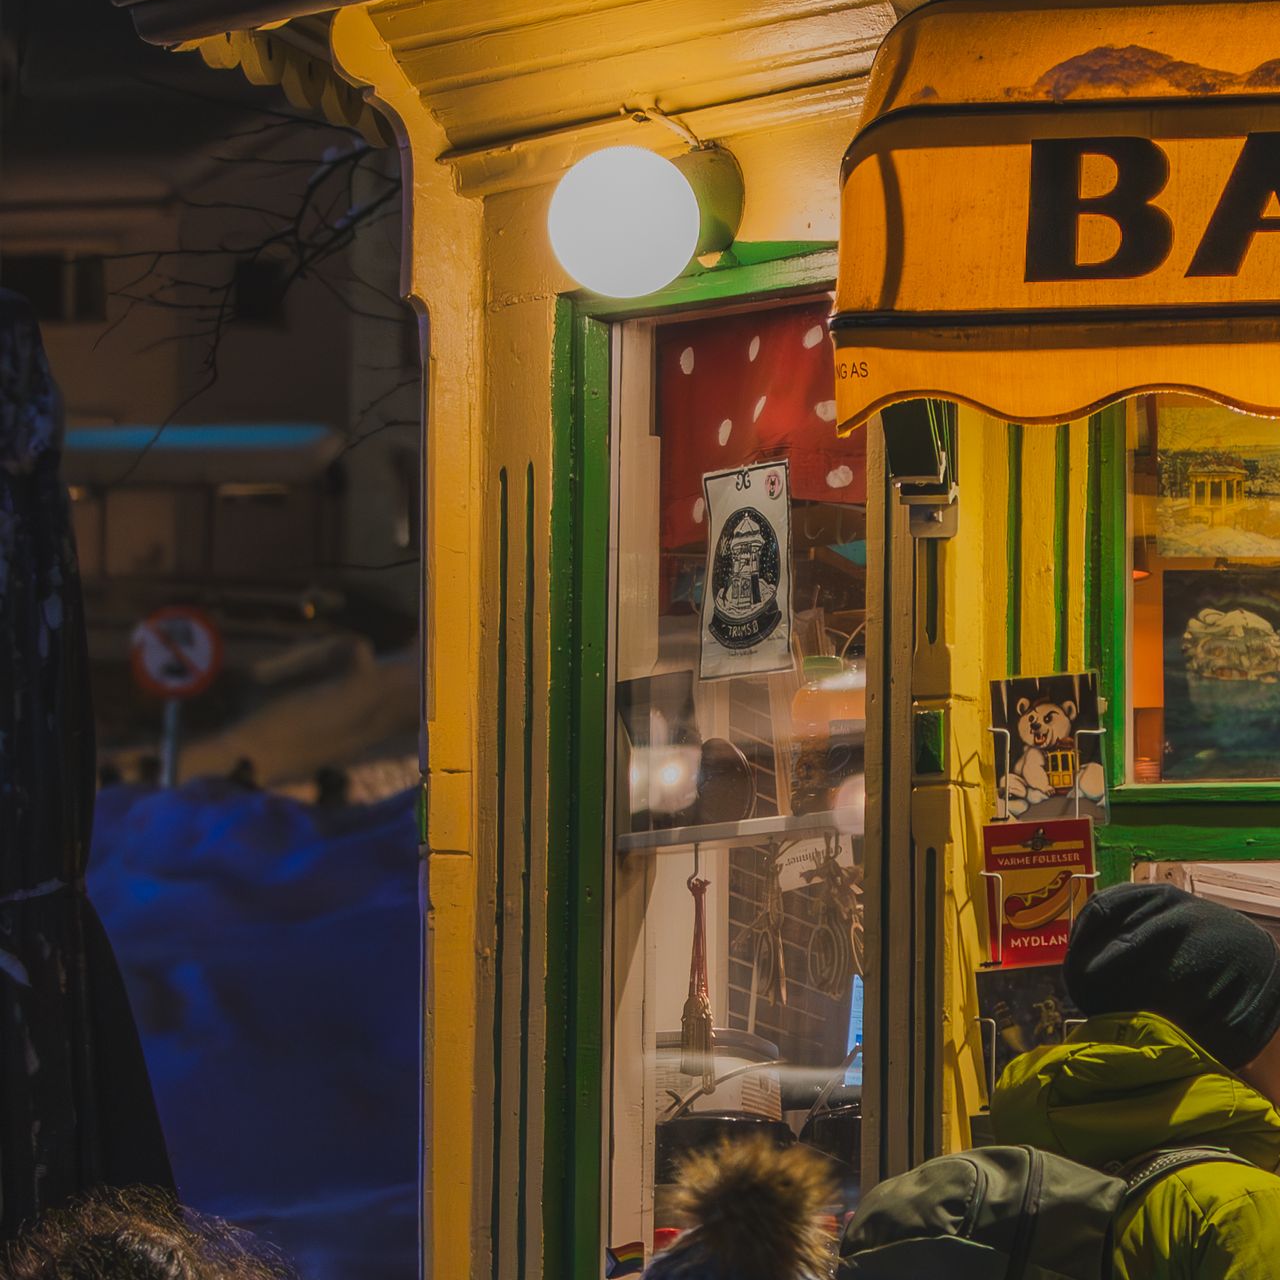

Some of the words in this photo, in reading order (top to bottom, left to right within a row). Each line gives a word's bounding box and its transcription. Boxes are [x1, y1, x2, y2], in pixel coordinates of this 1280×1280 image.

[851, 361, 869, 378] AS
[997, 856, 1031, 867] VARME
[1032, 852, 1081, 865] FØLELSER
[1010, 933, 1069, 949] MYDLAN
